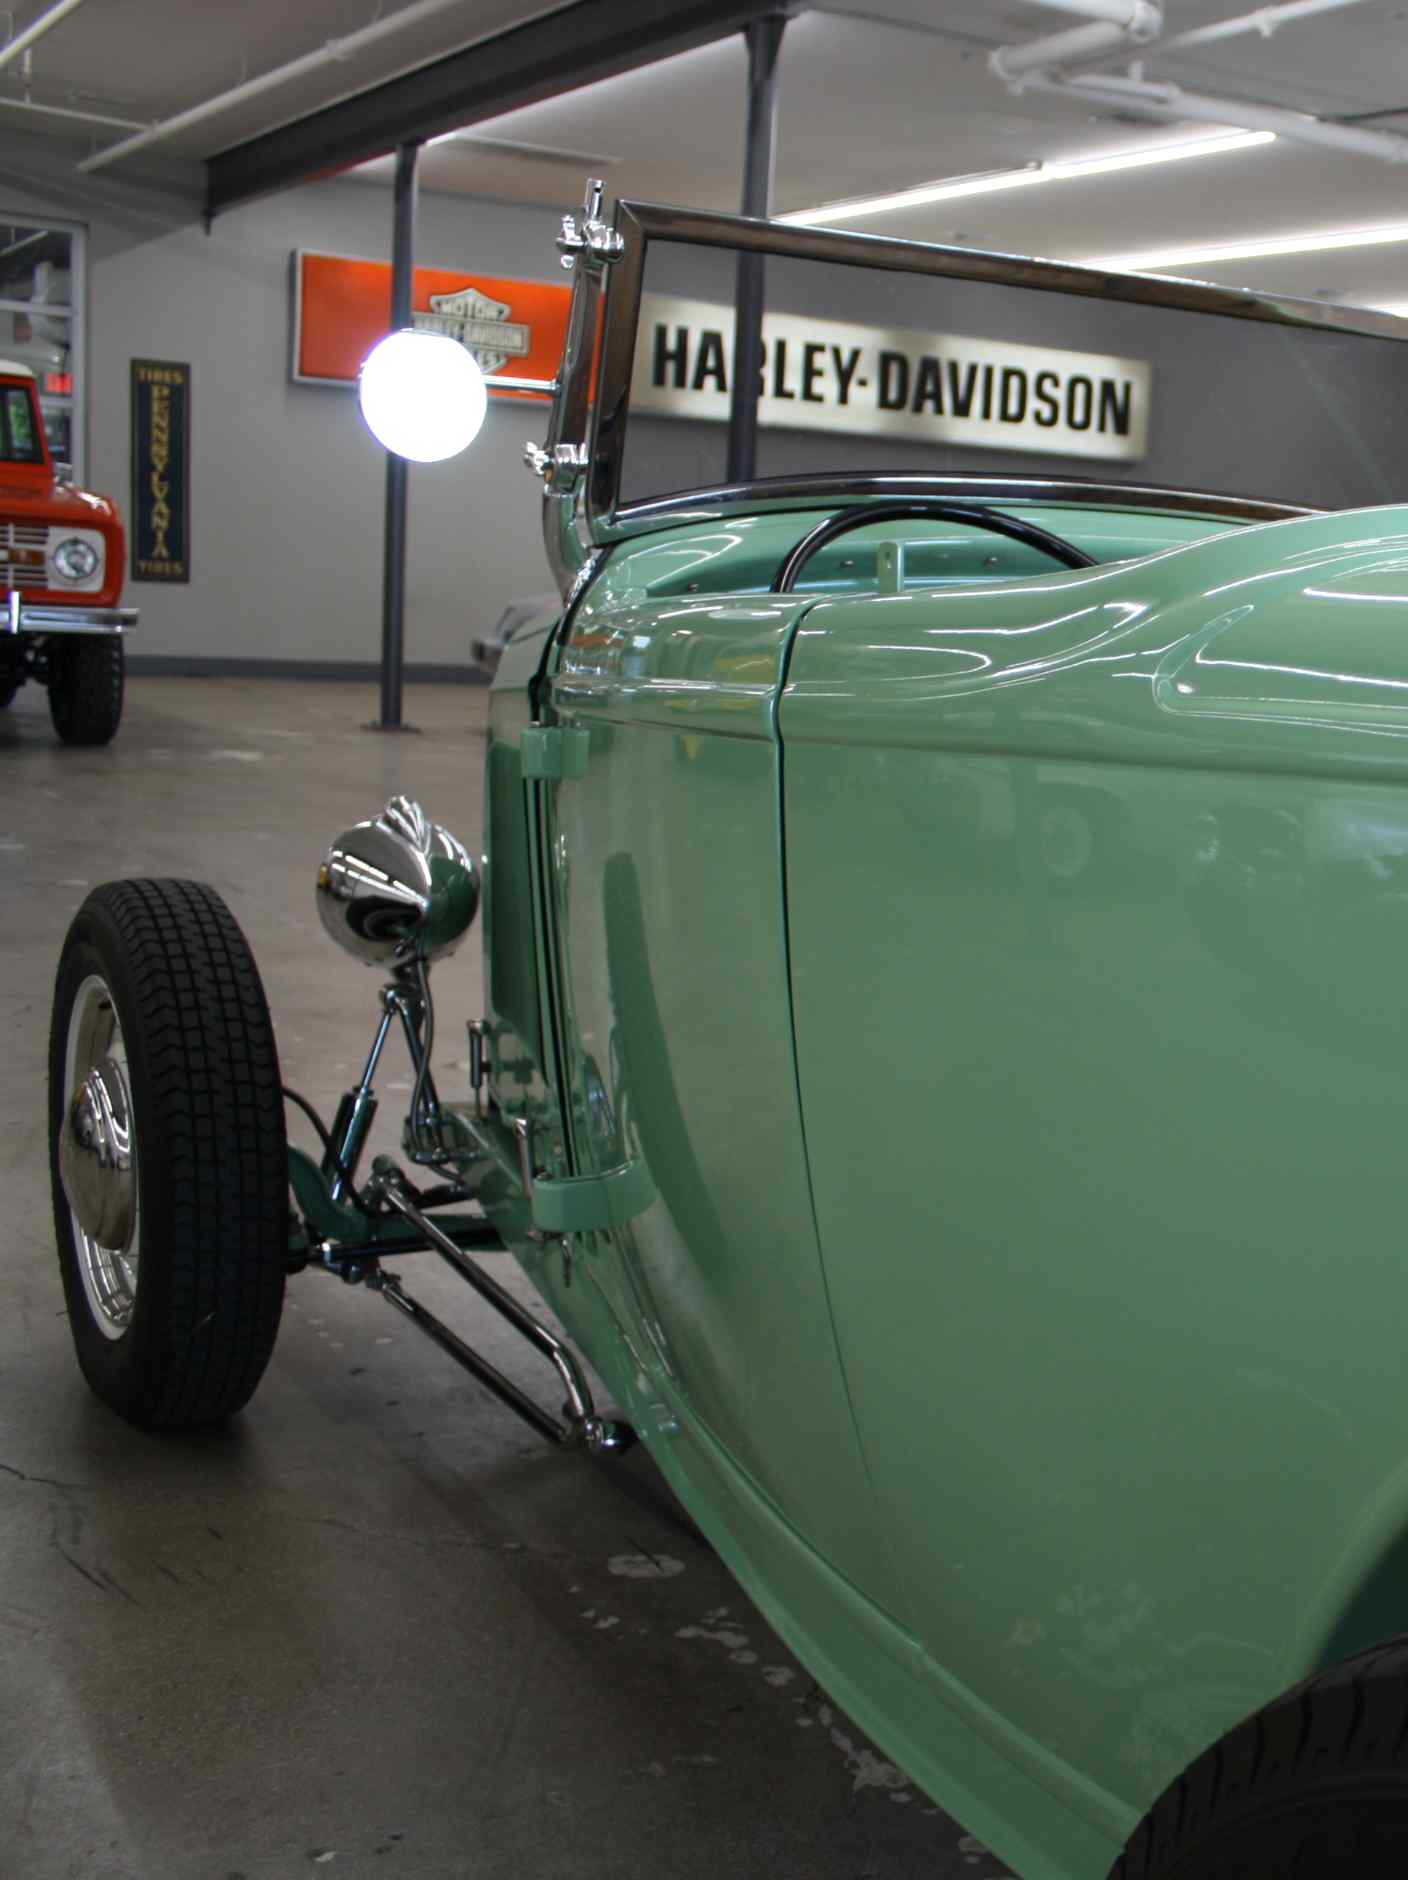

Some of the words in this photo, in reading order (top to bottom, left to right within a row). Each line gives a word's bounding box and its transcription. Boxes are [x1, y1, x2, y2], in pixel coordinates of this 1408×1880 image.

[136, 368, 183, 384] TIRES
[652, 323, 1132, 436] HALEY-DAVIDSON
[139, 560, 183, 575] TIRES
